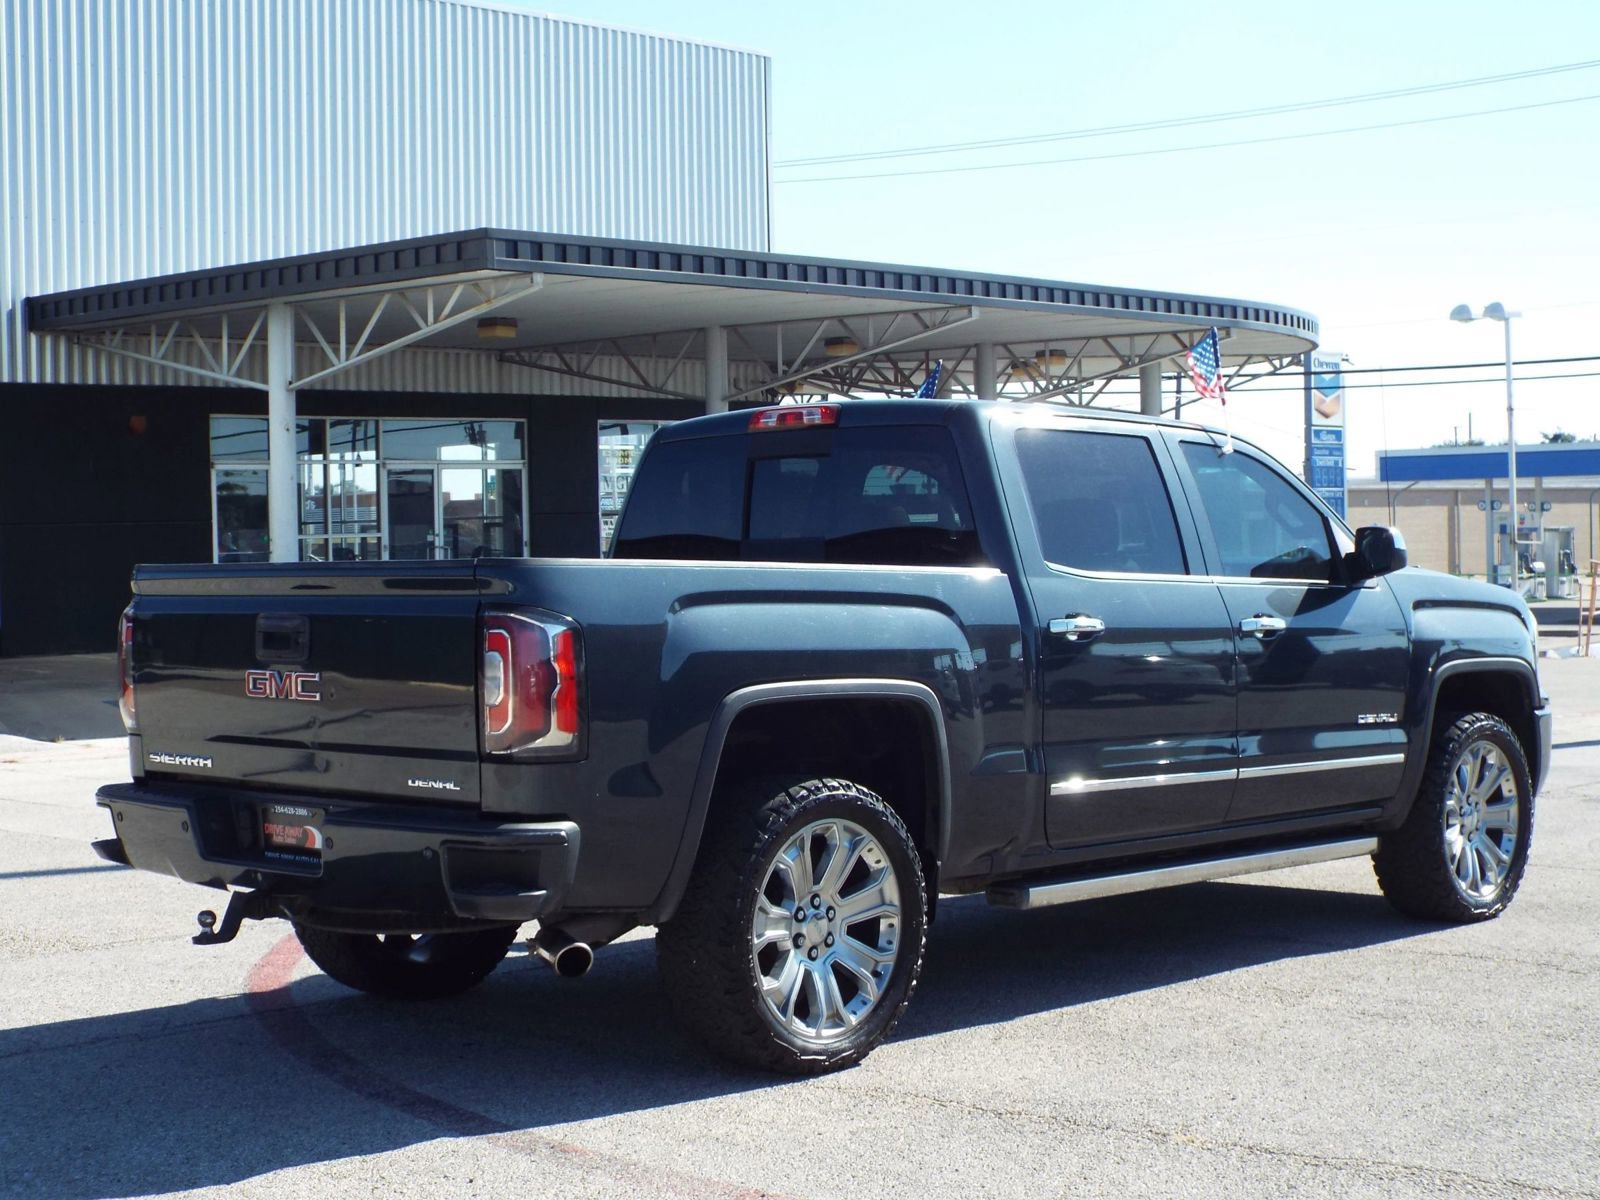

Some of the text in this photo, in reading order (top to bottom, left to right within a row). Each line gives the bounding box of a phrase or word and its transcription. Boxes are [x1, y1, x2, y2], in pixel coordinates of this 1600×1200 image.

[245, 669, 321, 701] GMC
[148, 751, 213, 769] SIERRA
[407, 778, 463, 791] DENAL
